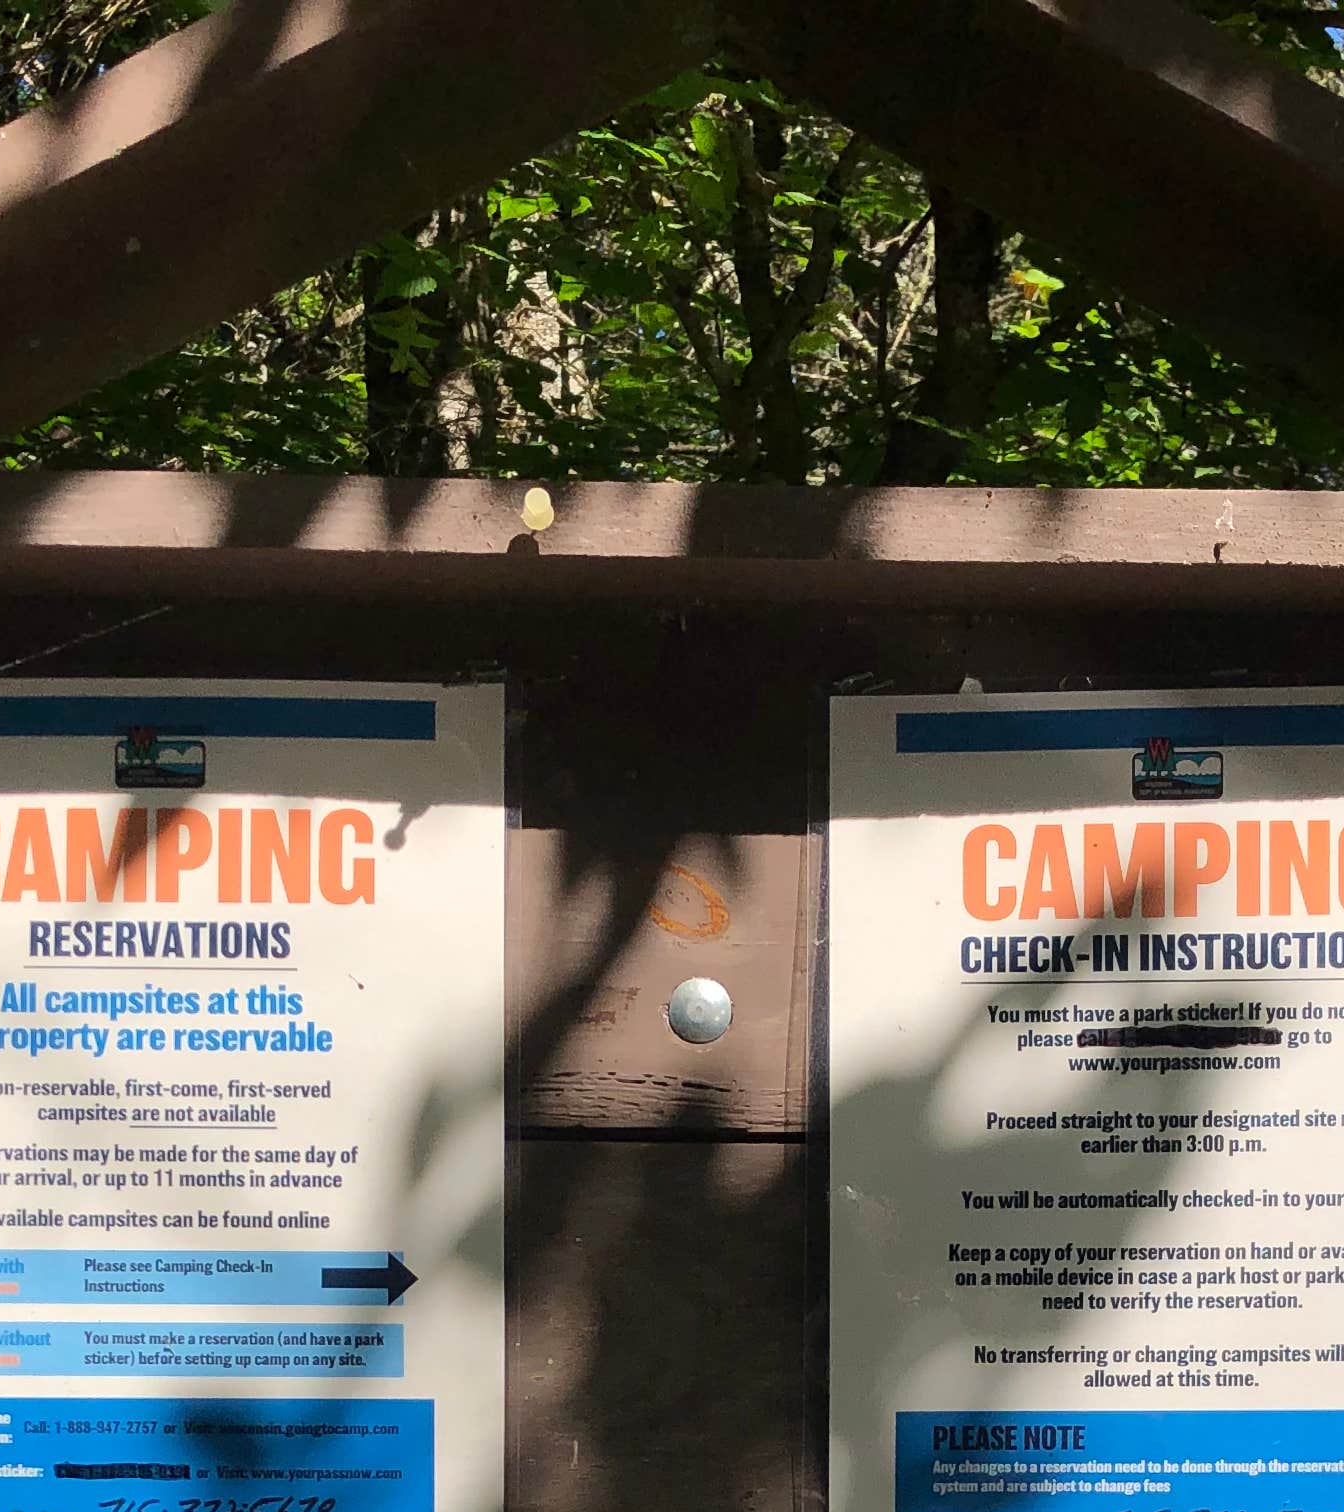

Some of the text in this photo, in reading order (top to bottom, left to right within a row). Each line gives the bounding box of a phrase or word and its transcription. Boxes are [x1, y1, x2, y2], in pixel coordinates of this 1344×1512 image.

[30, 921, 290, 958] RESERVATIONS
[961, 935, 1128, 975] CHECK-IN
[1, 983, 302, 1021] All campsites at this
[988, 1006, 1019, 1023] You
[1025, 1007, 1069, 1022] must
[1074, 1005, 1114, 1022] have
[1119, 1009, 1129, 1021] a
[1134, 1005, 1173, 1026] park
[1178, 1003, 1243, 1021] sticker!
[1248, 1003, 1261, 1020] If
[1266, 1006, 1296, 1024] you
[1303, 1002, 1322, 1019] do
[117, 1028, 166, 1051] are
[174, 1022, 333, 1052] reservable
[1018, 1030, 1073, 1050] please
[1288, 1032, 1309, 1048] go
[1314, 1029, 1332, 1044] to
[1069, 1057, 1280, 1075] www.yourpassnow.com
[125, 1079, 222, 1099] first-come,
[228, 1080, 331, 1098] first-served
[38, 1103, 275, 1124] campsites are not available
[987, 1112, 1056, 1129] Proceed
[1061, 1111, 1132, 1133] straight
[1136, 1113, 1154, 1128] to
[1159, 1115, 1198, 1132] your
[1203, 1110, 1299, 1131] designated
[1305, 1110, 1336, 1126] site
[1081, 1135, 1266, 1156] earlier than 3:00 p.m.
[69, 1210, 157, 1231] campsites
[163, 1216, 192, 1227] can
[199, 1211, 218, 1227] be
[223, 1211, 272, 1228] found
[278, 1211, 329, 1228] online
[85, 1259, 273, 1275] Please see Camping Check-In
[85, 1279, 164, 1292] Instructions
[85, 1351, 134, 1365] sticker)
[139, 1352, 181, 1364] before
[185, 1352, 232, 1368] setting
[236, 1356, 251, 1368] up
[255, 1356, 290, 1368] camp
[294, 1356, 309, 1365] on
[312, 1356, 336, 1368] any
[24, 1421, 50, 1434] Call:
[55, 1421, 157, 1434] 1-888-947-2757
[164, 1425, 177, 1434] or
[933, 1425, 1085, 1452] PLEASE NOTE
[197, 1470, 210, 1478] or
[249, 1467, 402, 1482] www.yourpassnow.com
[933, 1477, 1171, 1495] system and are subject to change fees
